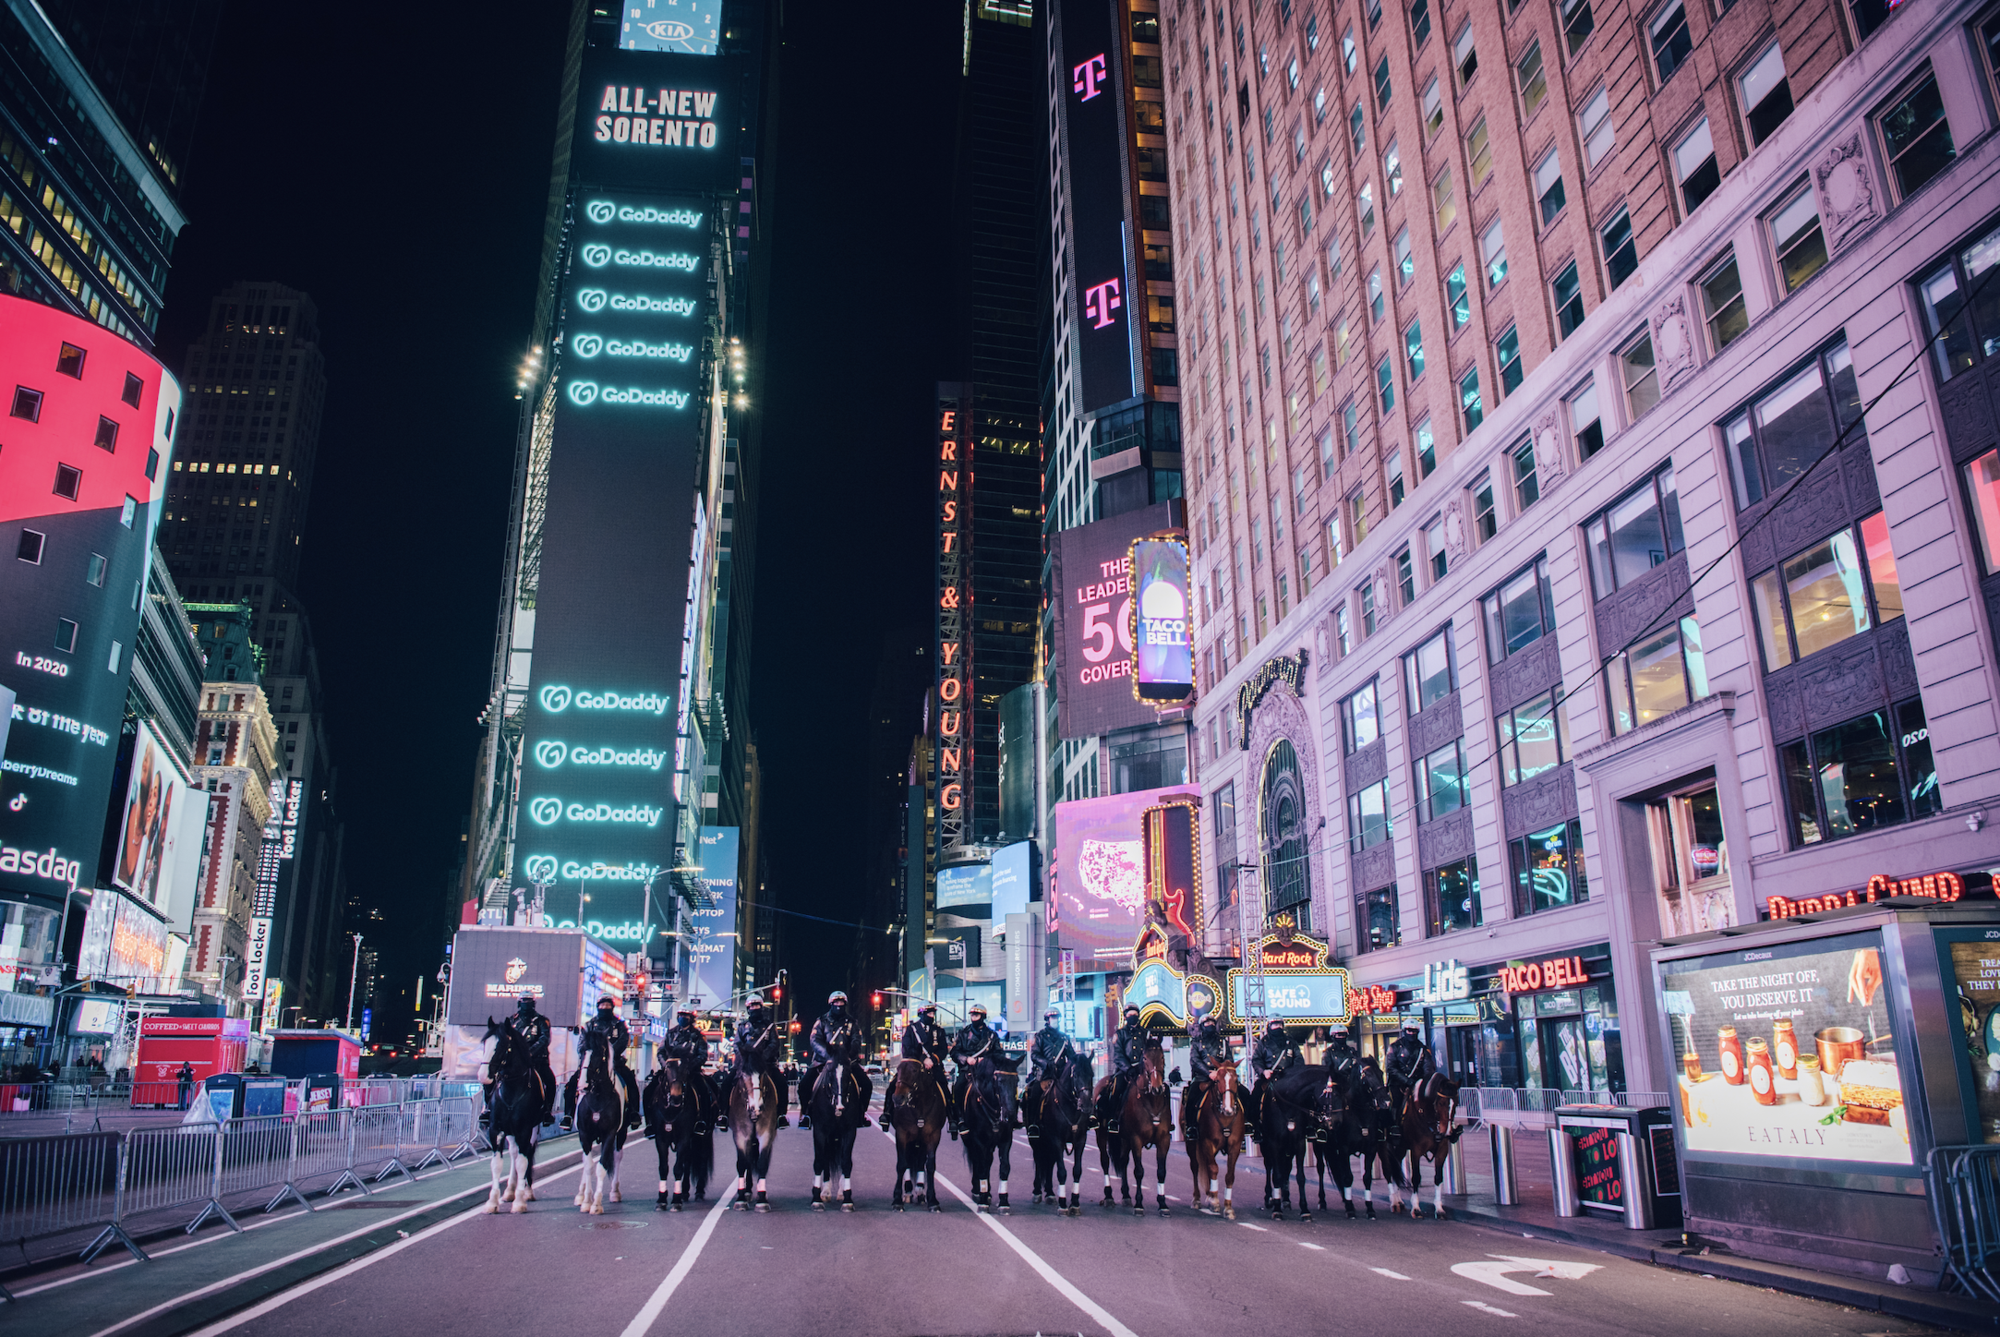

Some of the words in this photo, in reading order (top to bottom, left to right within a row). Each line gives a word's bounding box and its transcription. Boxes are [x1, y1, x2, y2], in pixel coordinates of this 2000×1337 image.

[631, 8, 641, 18] 10
[692, 2, 696, 12] 1
[624, 22, 630, 32] 9
[704, 14, 711, 24] 2
[654, 24, 686, 38] KIA
[710, 29, 717, 39] 3
[701, 44, 708, 54] 4
[600, 85, 717, 118] ALL-NEW
[594, 115, 717, 148] SORENTO
[618, 207, 702, 229] GoDaddy
[614, 250, 699, 272] GoDaddy
[609, 295, 697, 317] GoDaddy
[606, 340, 693, 363] GoDaddy
[601, 387, 690, 410] GoDaddy
[939, 411, 960, 553] ERNST
[1100, 557, 1131, 579] THE
[939, 587, 960, 609] &
[1142, 619, 1186, 633] TACO
[1146, 632, 1188, 646] BELL
[16, 651, 32, 668] In
[33, 656, 69, 678] 2020
[575, 691, 670, 715] GoDaddy
[939, 642, 962, 809] YOUNG
[570, 747, 667, 770] GoDaddy
[282, 779, 303, 826] Locker
[566, 803, 663, 828] GoDaddy
[279, 828, 297, 860] Foot
[0, 847, 81, 891] asdaq
[561, 861, 660, 884] GoDaddy
[250, 921, 267, 964] Locker
[557, 920, 656, 944] Daddy
[949, 944, 960, 954] EY
[1260, 951, 1284, 965] Hard
[1286, 951, 1313, 967] Rock
[1743, 951, 1773, 961] JCDecaux
[246, 967, 261, 996] Foot
[1424, 958, 1470, 1003] Lids
[1497, 963, 1542, 993] TACO
[1543, 955, 1589, 987] BELL
[1710, 979, 1737, 993] TAKE
[1737, 976, 1759, 990] THE
[1759, 972, 1794, 988] NIGHT
[1795, 969, 1820, 984] OFF,
[1967, 979, 1996, 991] THEY
[1267, 988, 1297, 999] SAFE
[1270, 998, 1311, 1008] SOUND
[1370, 984, 1397, 1014] Shop
[1720, 994, 1745, 1010] YOU
[1746, 989, 1798, 1008] DESERVE
[1799, 988, 1813, 1003] IT
[0, 992, 50, 1024] CITIZEN
[143, 1023, 179, 1031] COFFEED
[1001, 1041, 1028, 1051] HASE
[310, 1087, 333, 1102] JERSEY
[1748, 1126, 1826, 1145] EATALY
[1602, 1139, 1618, 1161] LO
[1607, 1179, 1622, 1201] LO
